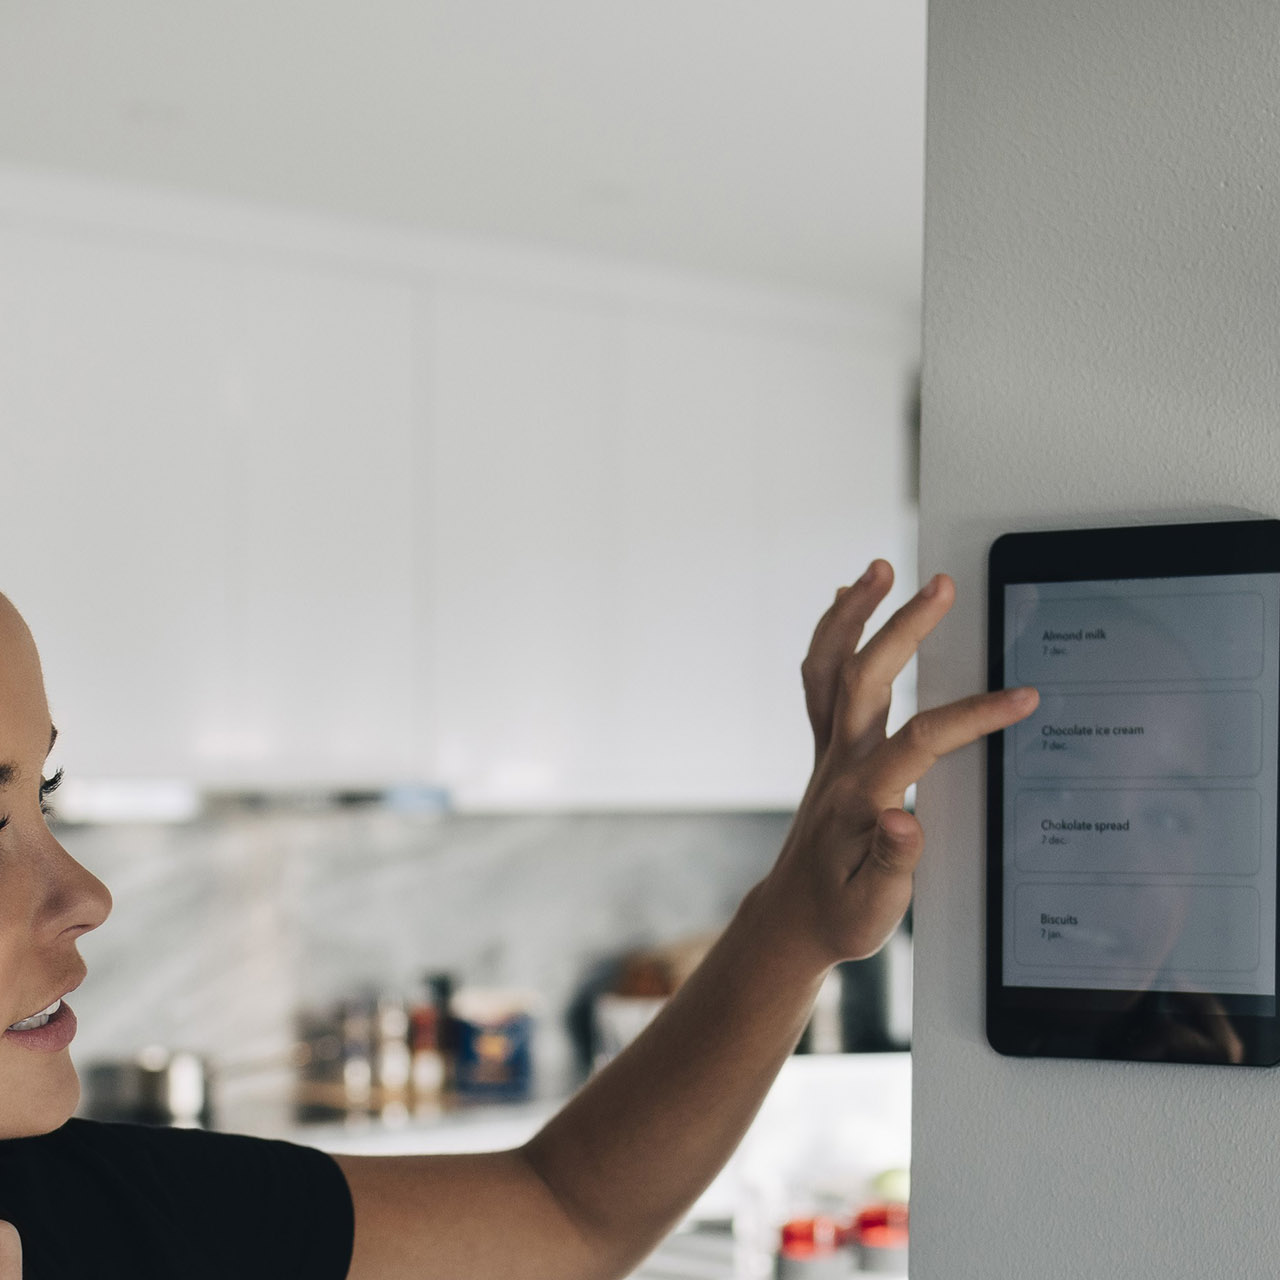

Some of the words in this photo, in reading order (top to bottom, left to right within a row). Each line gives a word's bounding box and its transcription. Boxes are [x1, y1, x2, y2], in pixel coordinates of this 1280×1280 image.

[1042, 630, 1082, 641] Almond
[1085, 629, 1106, 640] milk
[1041, 725, 1092, 736] Chocolate
[1095, 725, 1110, 735] ice
[1112, 726, 1145, 735] cream
[1041, 819, 1092, 831] Chokolate
[1094, 819, 1130, 833] spread
[1040, 913, 1078, 925] Biscuits
